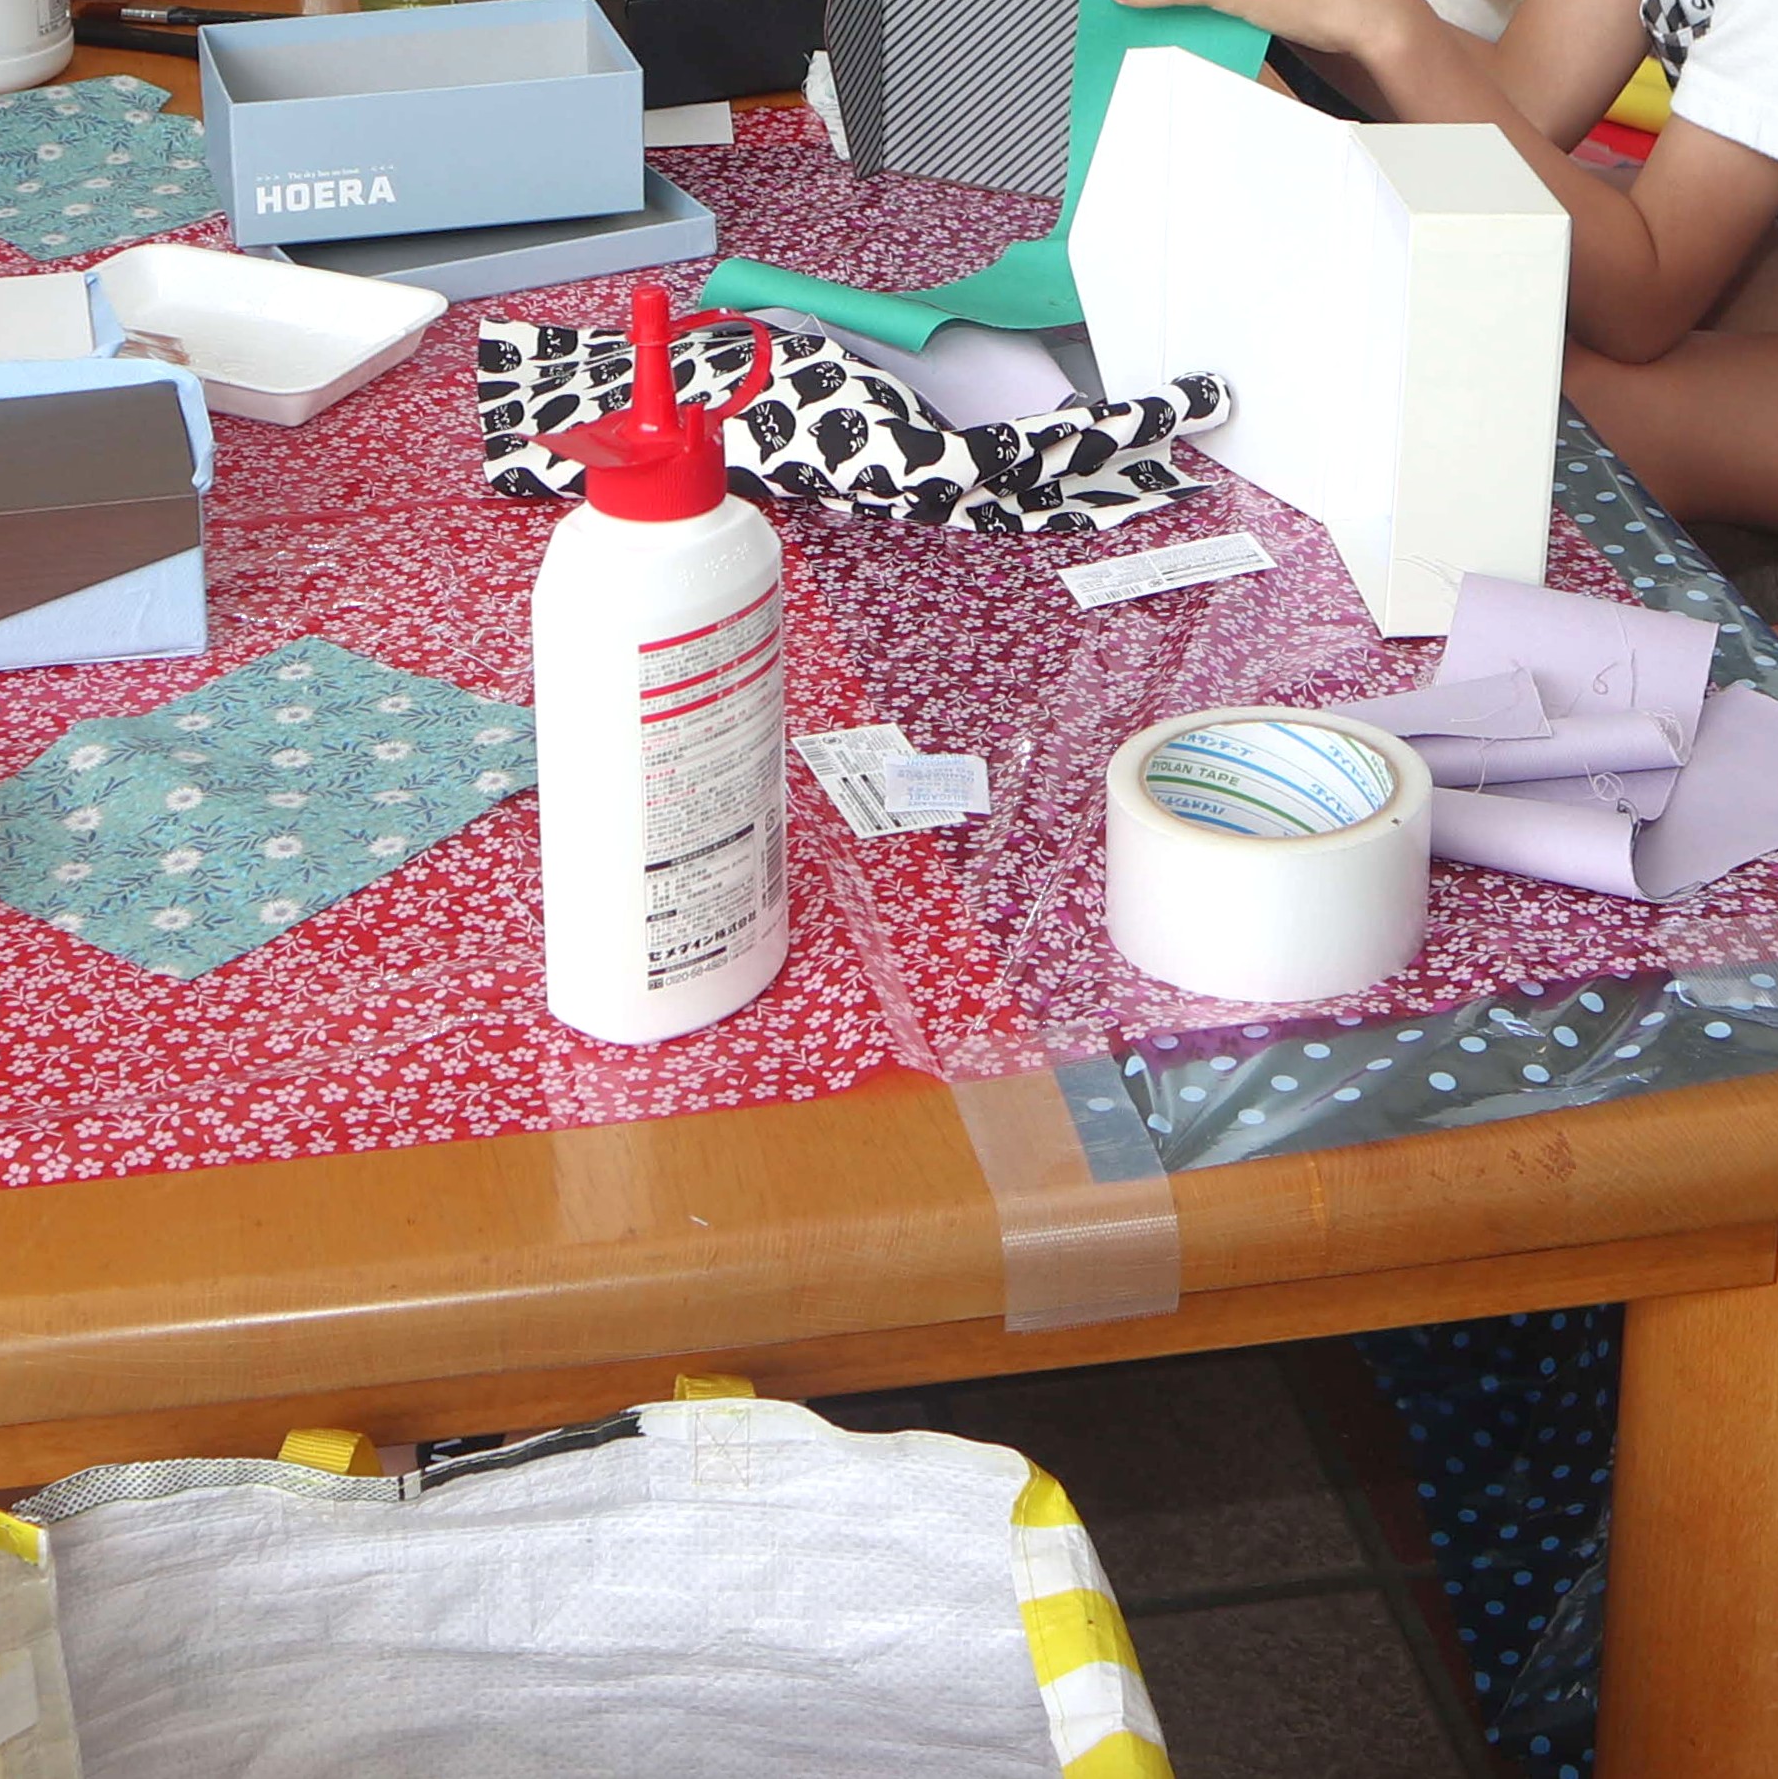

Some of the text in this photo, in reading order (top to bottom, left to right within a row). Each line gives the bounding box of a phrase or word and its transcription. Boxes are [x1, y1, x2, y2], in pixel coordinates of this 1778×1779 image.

[256, 175, 398, 215] HOERA
[1199, 766, 1241, 787] TAPE
[647, 909, 757, 963] セメダイン株式会社
